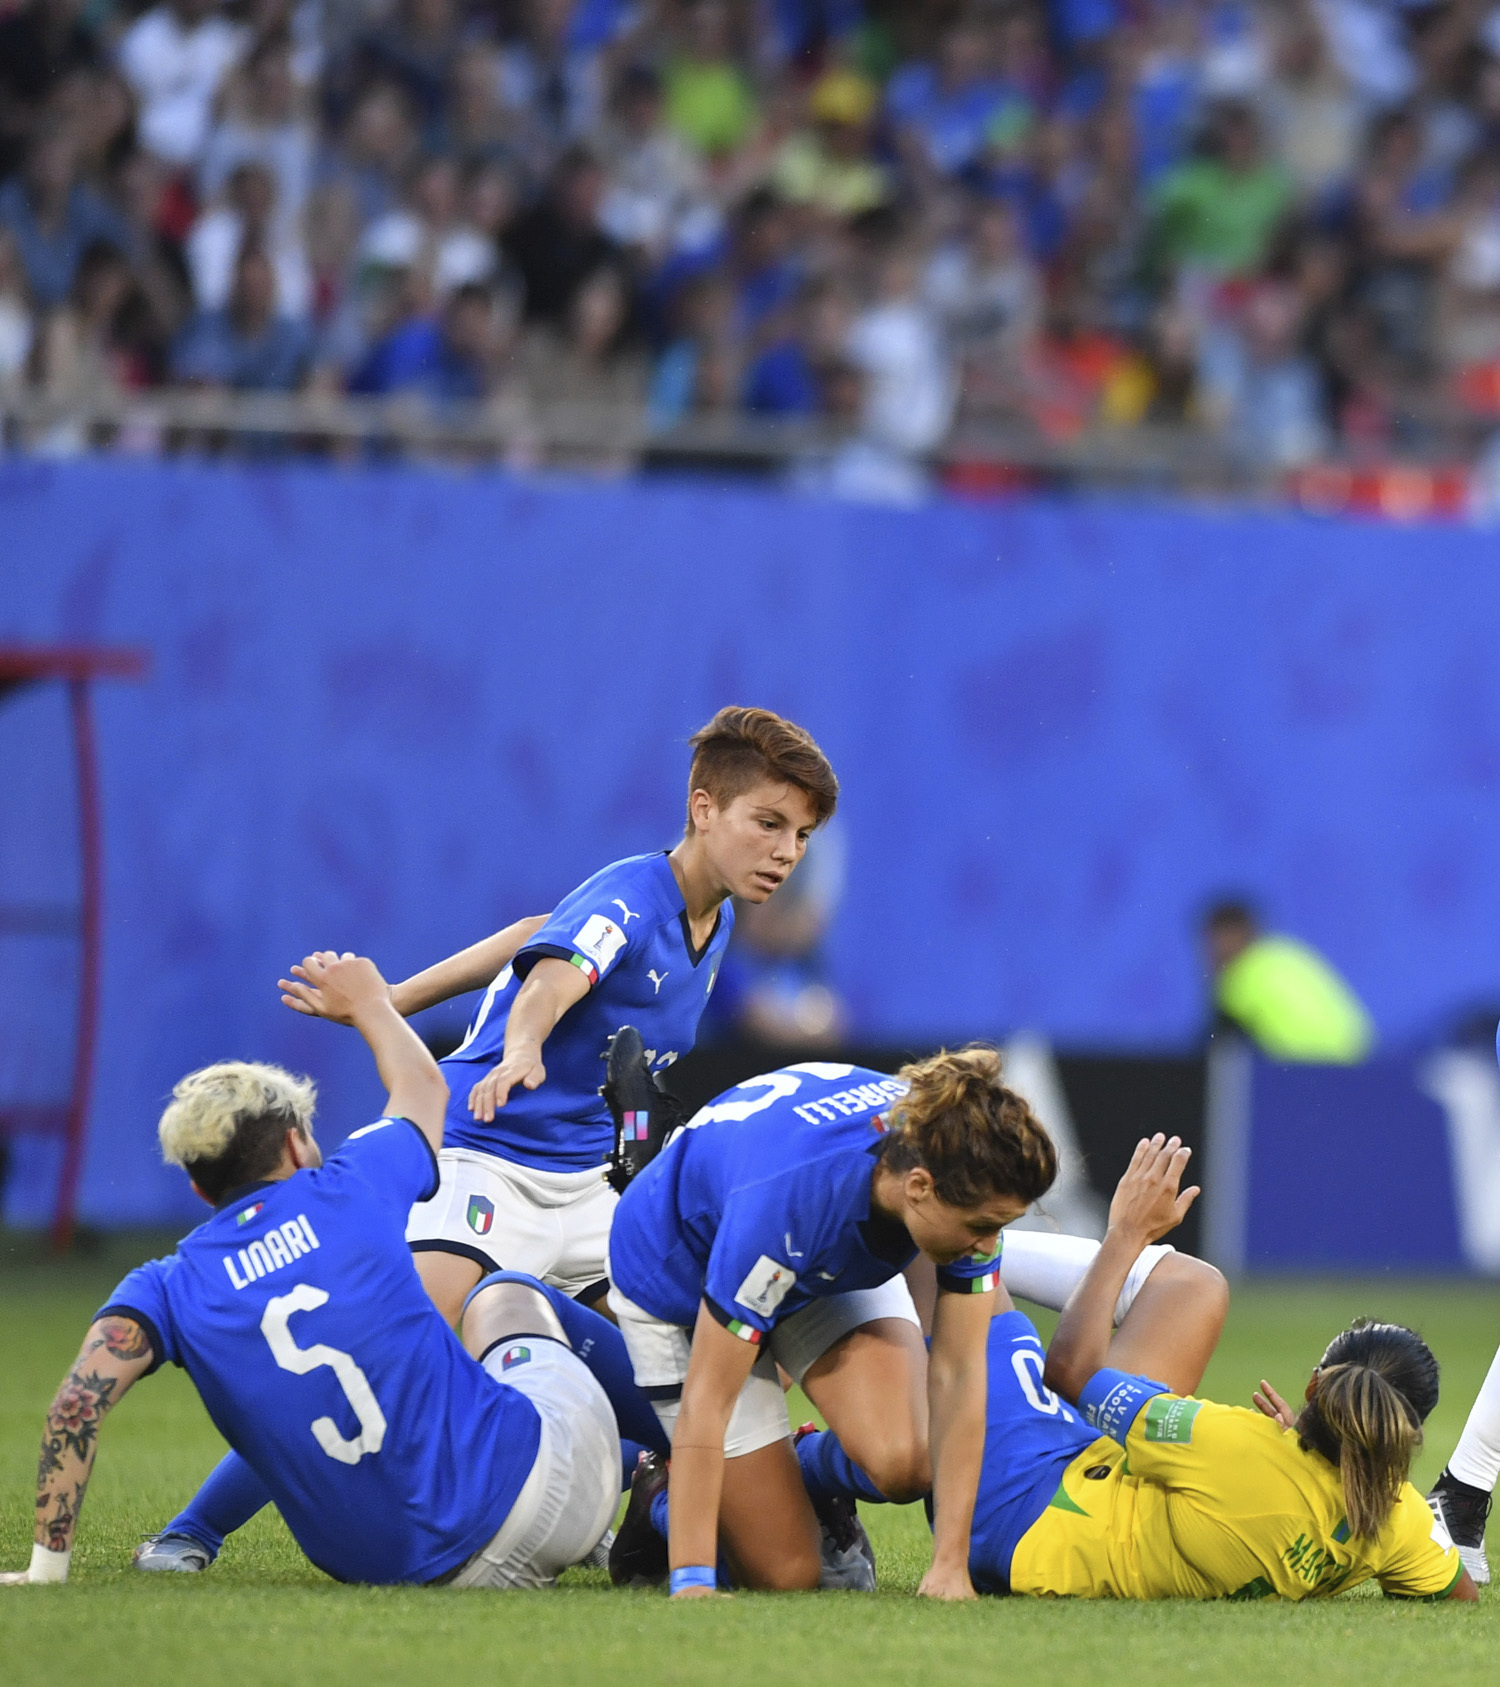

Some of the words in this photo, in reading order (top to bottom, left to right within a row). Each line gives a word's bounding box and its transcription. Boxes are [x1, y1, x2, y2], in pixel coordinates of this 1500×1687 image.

[793, 1080, 911, 1125] GIRELLI
[222, 1213, 320, 1291] LINARI
[260, 1283, 387, 1466] 5
[1101, 1384, 1135, 1436] FOOTBA
[1109, 1388, 1142, 1438] LIVIN
